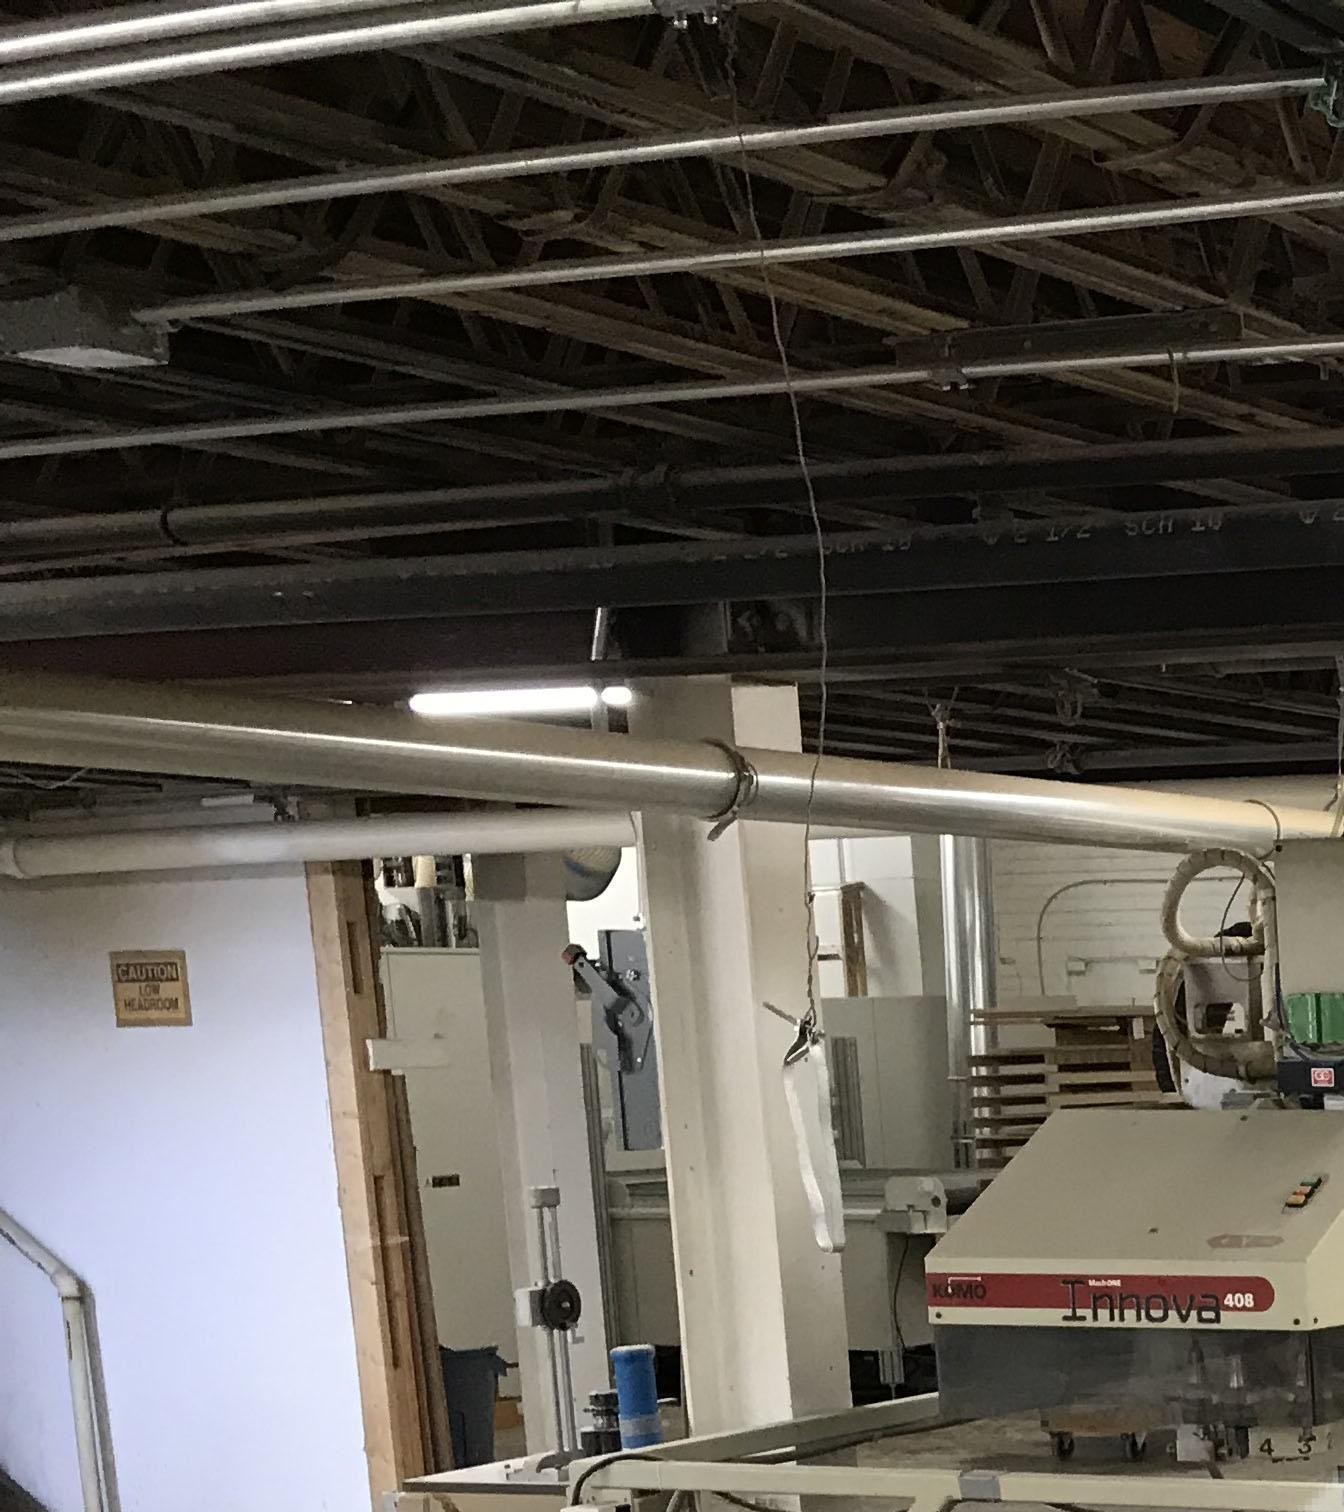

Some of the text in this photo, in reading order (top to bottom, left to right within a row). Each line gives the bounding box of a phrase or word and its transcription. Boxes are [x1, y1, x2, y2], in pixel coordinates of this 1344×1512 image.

[117, 963, 179, 981] CAUTION
[139, 982, 161, 998] LOW
[932, 1282, 987, 1300] KOMO
[1060, 1279, 1254, 1324] Innova 408
